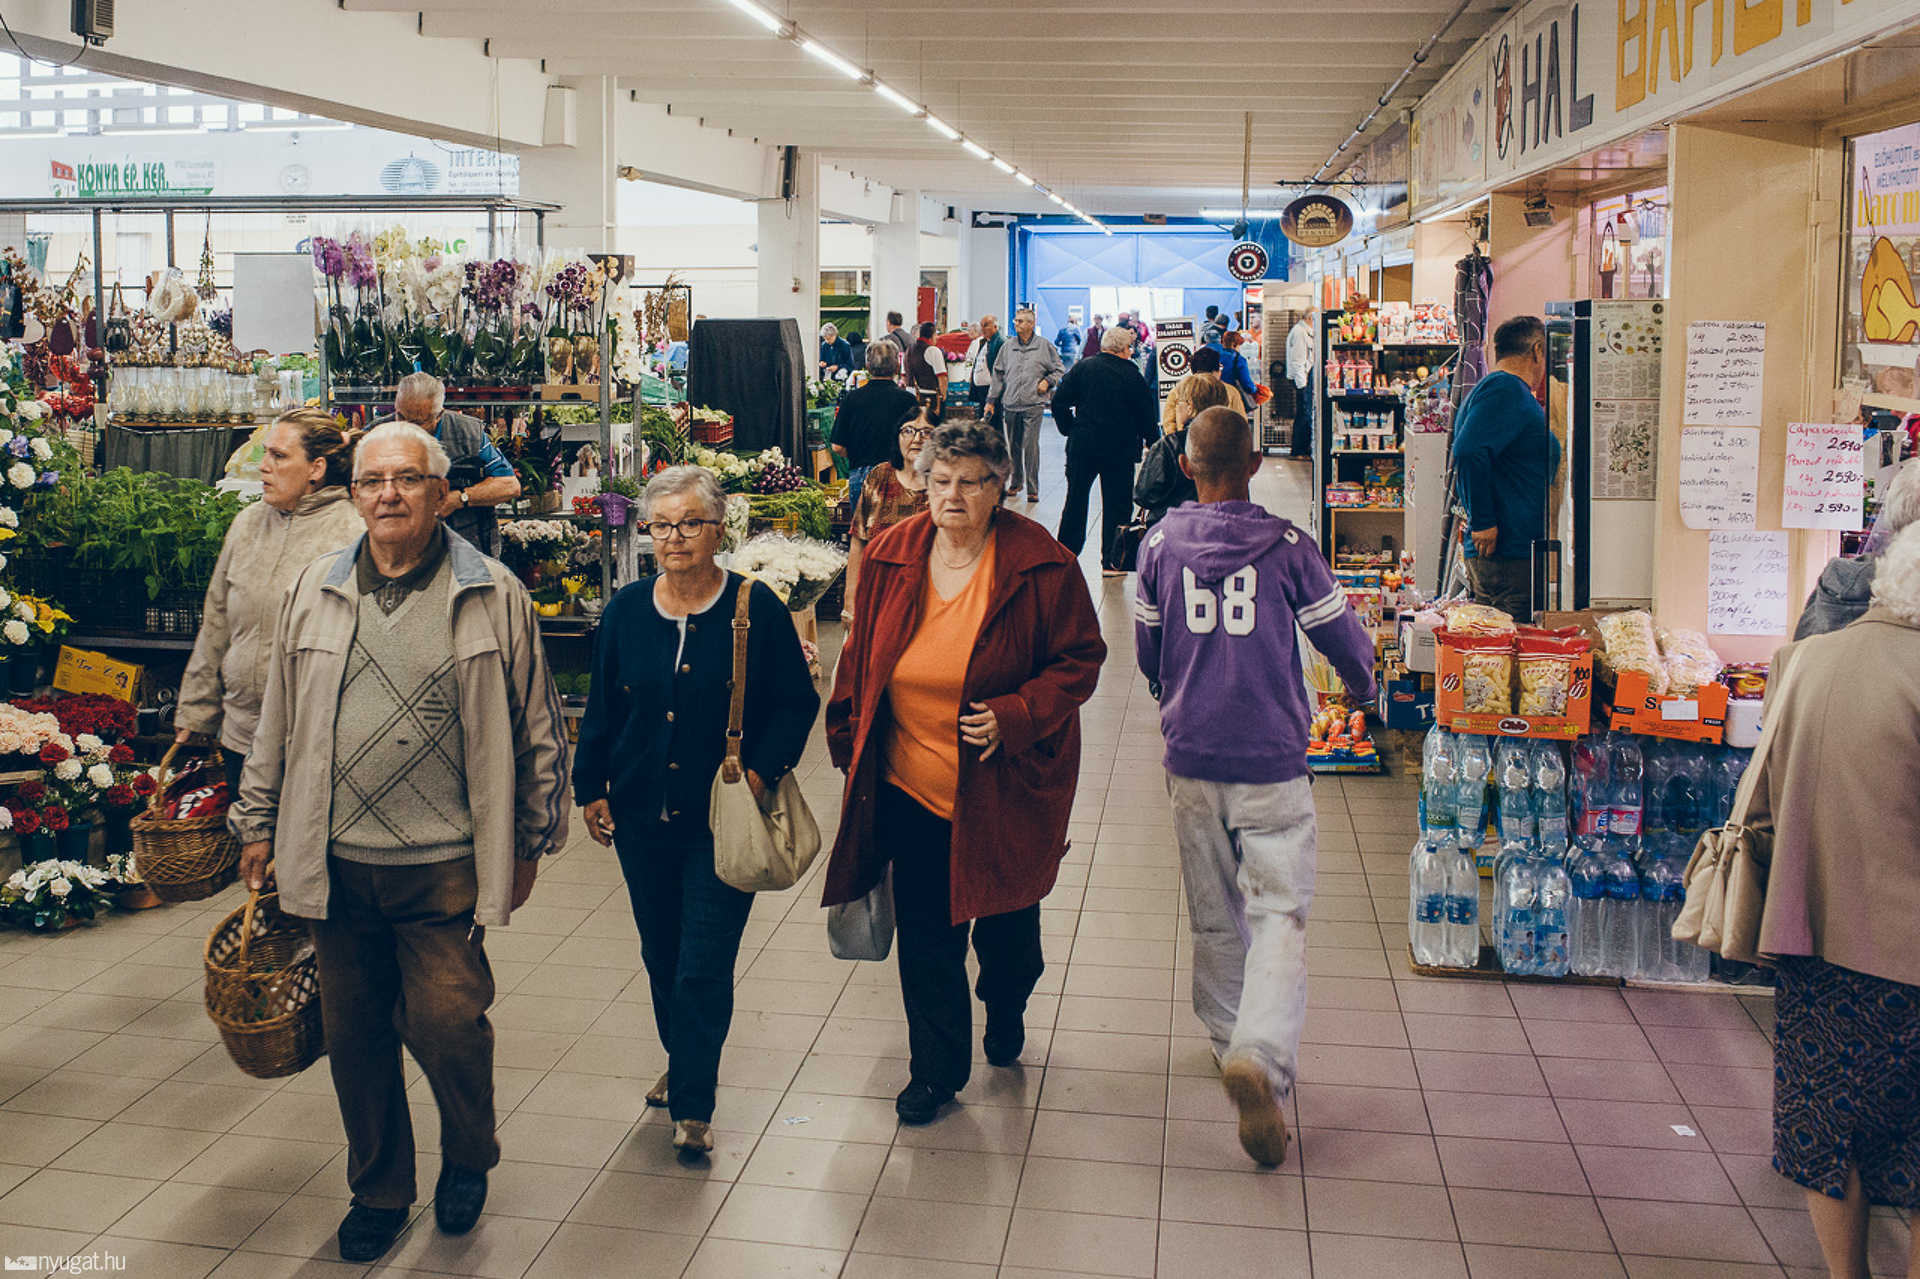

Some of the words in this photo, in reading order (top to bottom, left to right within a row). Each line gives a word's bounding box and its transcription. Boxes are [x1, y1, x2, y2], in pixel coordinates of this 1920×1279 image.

[1520, 2, 1594, 155] HAL
[77, 154, 119, 192] KÓNYA
[123, 154, 140, 192] ÉP.
[143, 162, 169, 192] KER.
[1182, 564, 1258, 636] 68
